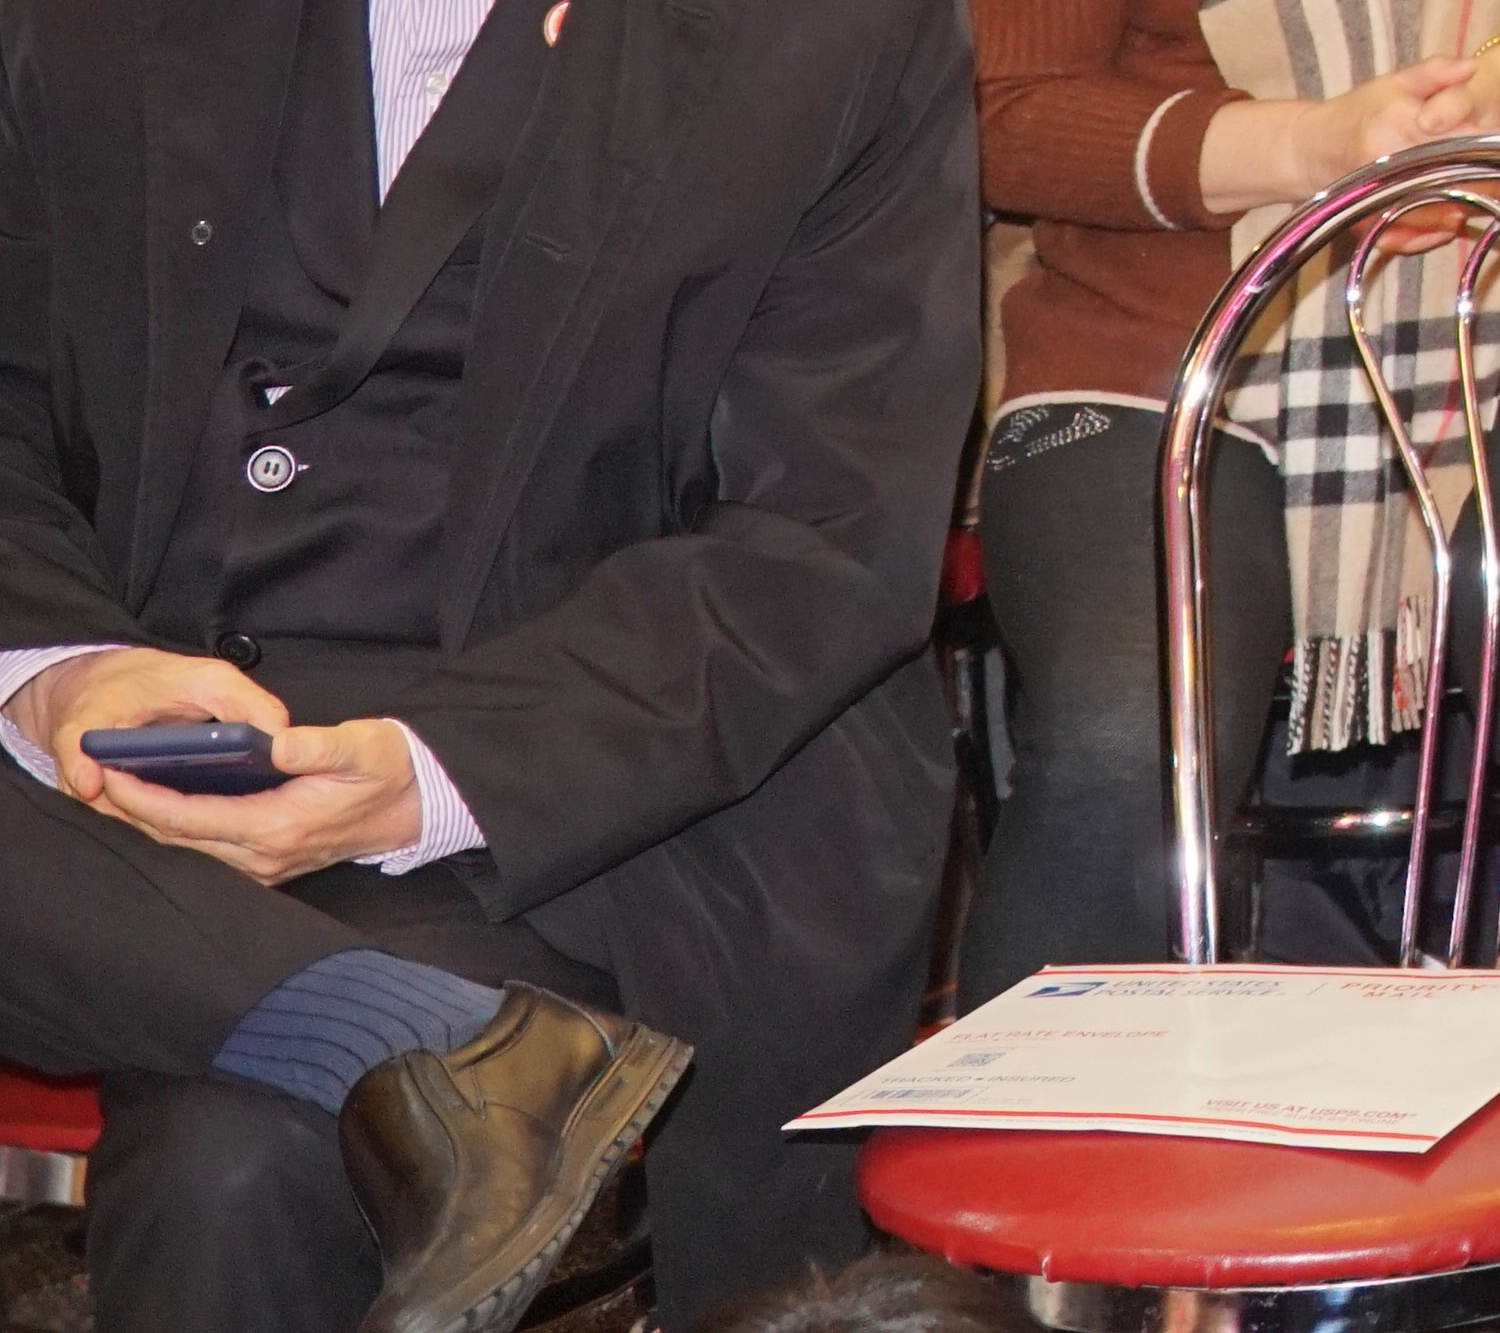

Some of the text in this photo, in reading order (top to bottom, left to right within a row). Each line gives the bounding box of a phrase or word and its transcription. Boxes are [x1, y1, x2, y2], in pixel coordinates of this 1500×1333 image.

[1340, 982, 1488, 991] PRIORITY
[1363, 991, 1434, 999] MAIL
[1062, 1030, 1169, 1039] ENVELOPE
[881, 1074, 1076, 1084] TRACKED INSURED
[1206, 1099, 1252, 1108] VISIT
[1254, 1101, 1280, 1110] US
[1282, 1105, 1308, 1113] AT
